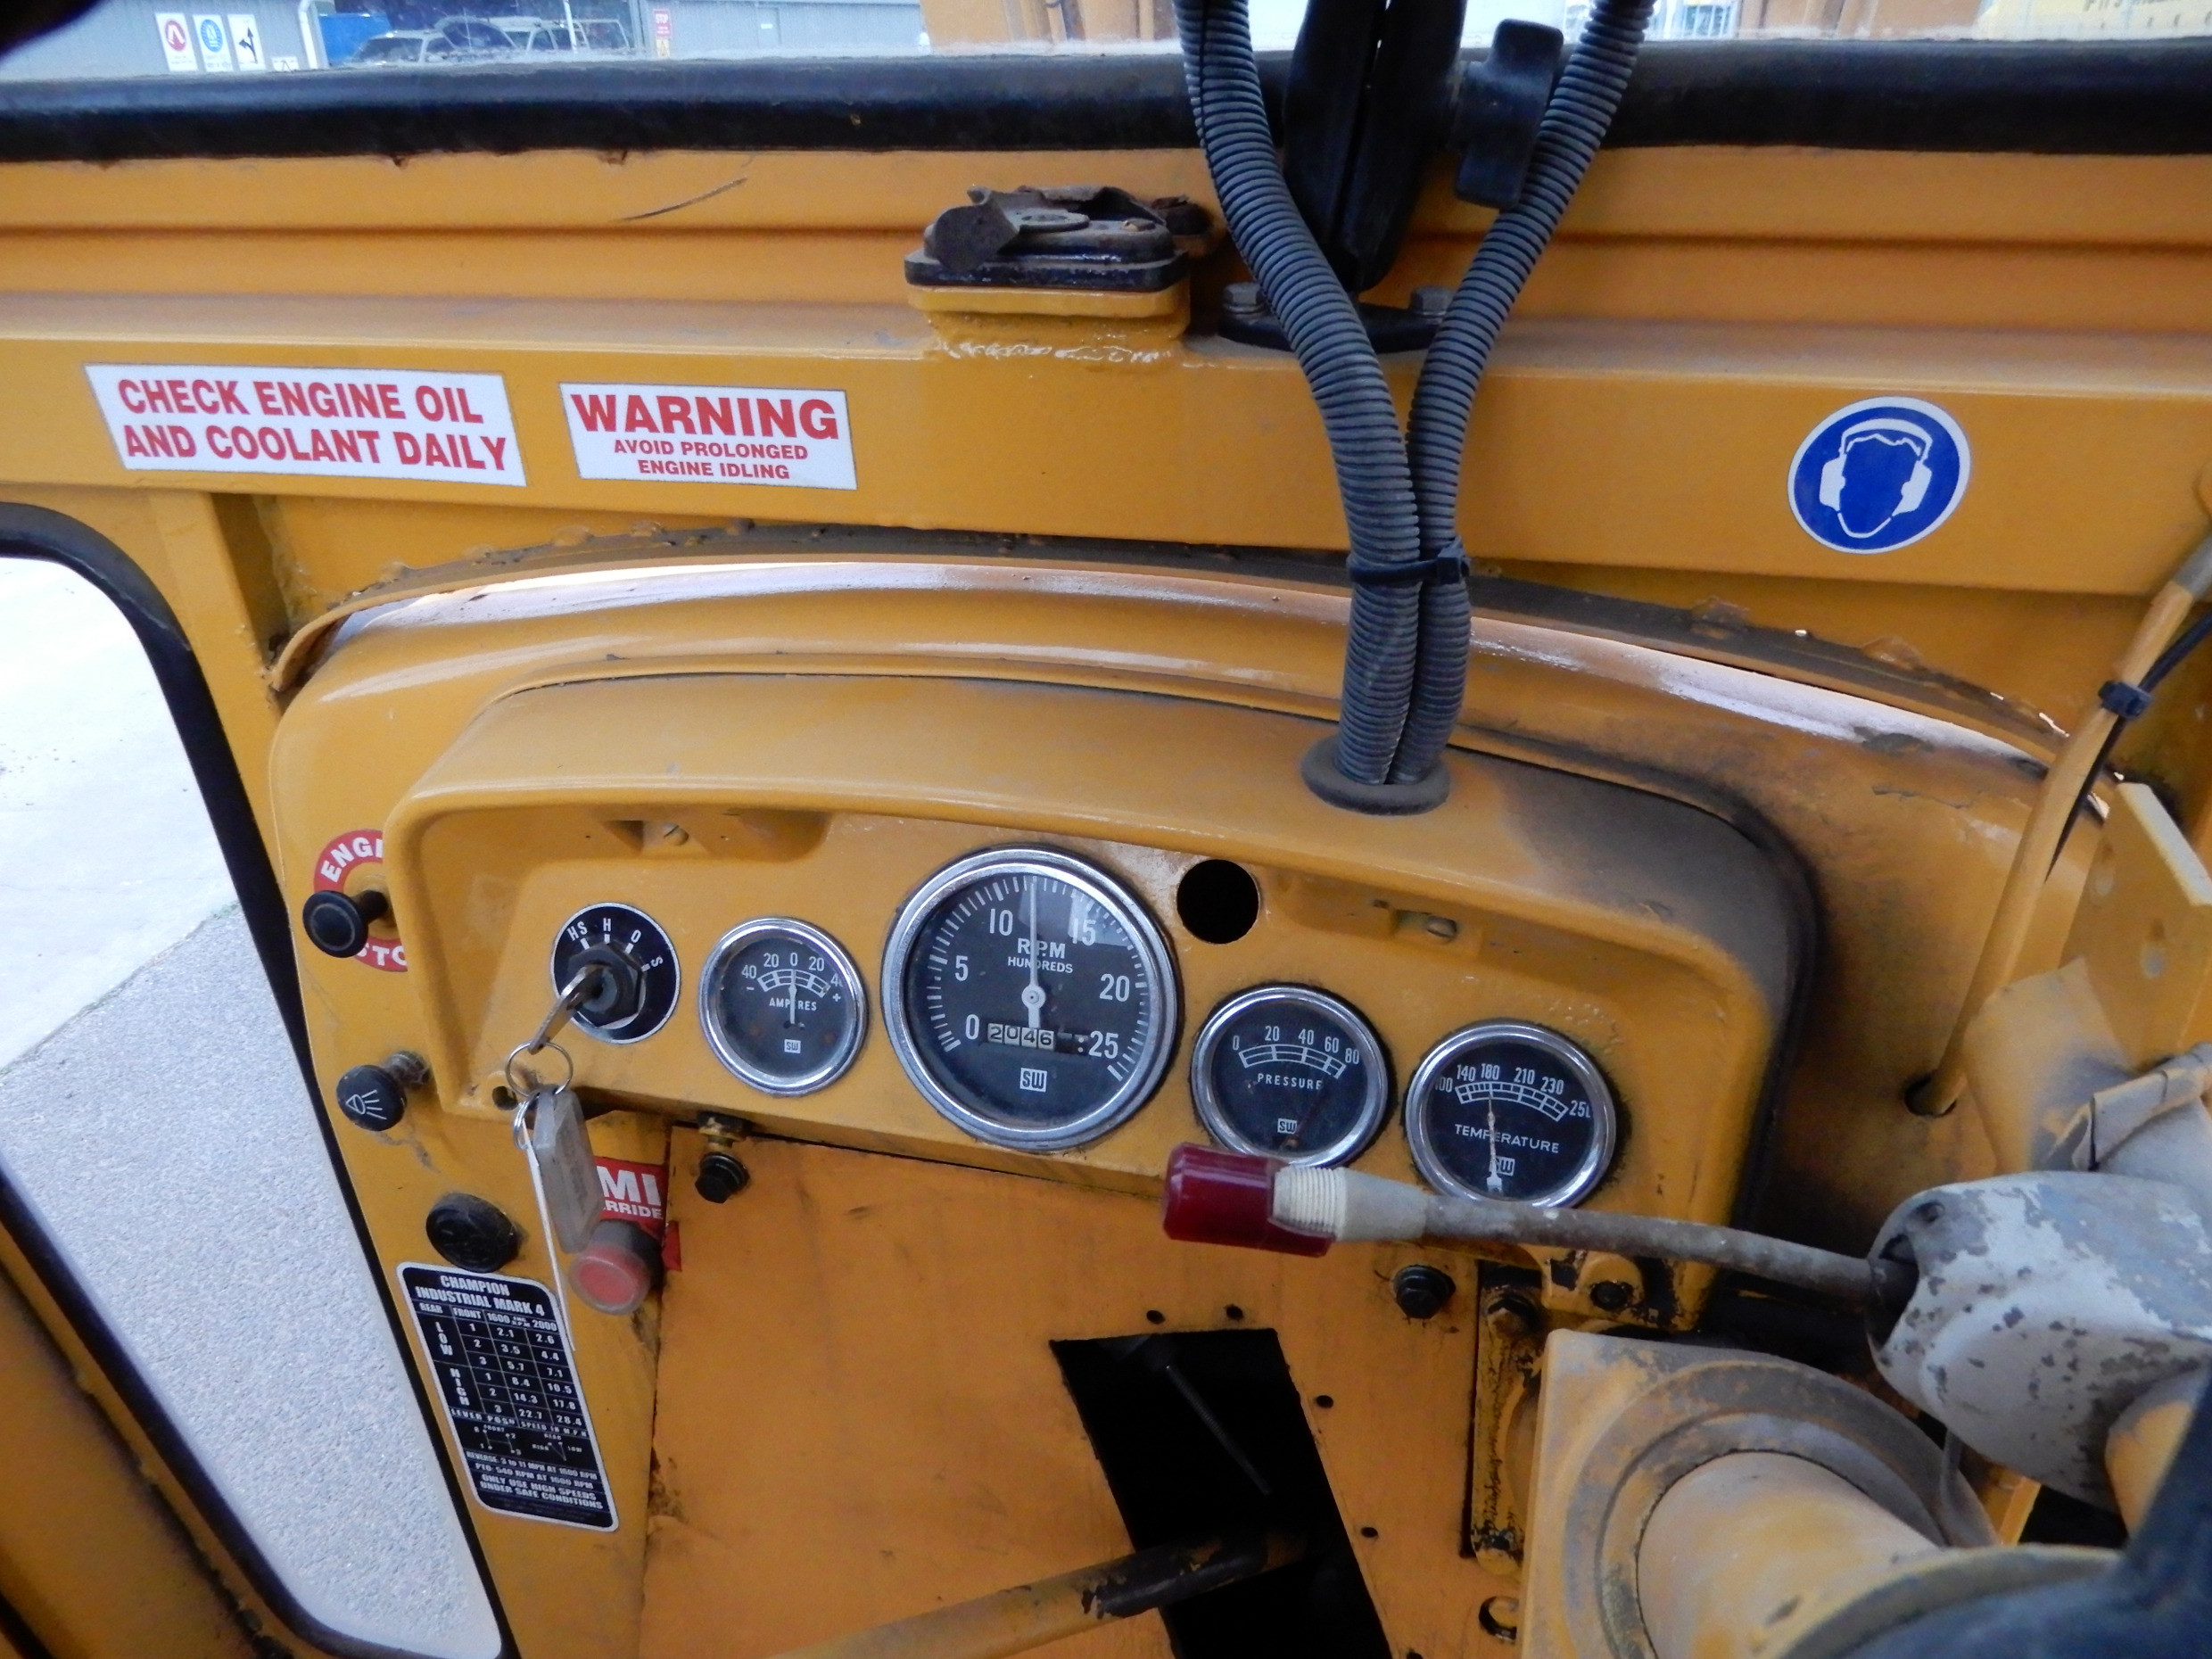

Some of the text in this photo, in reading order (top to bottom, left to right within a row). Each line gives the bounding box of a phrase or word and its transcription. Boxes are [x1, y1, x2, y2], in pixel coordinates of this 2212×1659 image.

[118, 379, 484, 424] CHECK ENGINE OIL
[570, 394, 838, 440] WARNING
[123, 425, 507, 471] AND COOLANT DAILY
[615, 439, 808, 460] AVOID PROLONGED
[637, 459, 790, 479] ENGINE IDLING
[320, 837, 384, 883] ENGI
[988, 908, 1013, 936] 10
[1072, 918, 1097, 946] 15
[356, 942, 409, 966] STO
[567, 920, 588, 941] HS
[603, 918, 611, 931] H
[650, 956, 664, 968] S
[741, 964, 757, 979] 40
[763, 953, 780, 968] 20
[790, 952, 798, 967] 0
[808, 956, 825, 972] 20
[954, 955, 969, 981] 5
[1099, 973, 1130, 1003] 20
[769, 997, 817, 1011] AMPRES
[964, 1013, 979, 1040] 0
[785, 1040, 800, 1052] SW
[1088, 1030, 1119, 1060] 25
[1233, 1026, 1359, 1065] 0 20 40 60 80
[1020, 1069, 1046, 1092] SW
[1258, 1073, 1324, 1091] PRESSURE
[1457, 1064, 1476, 1082] 140
[1481, 1063, 1500, 1080] 180
[1514, 1067, 1536, 1085] 210
[1540, 1076, 1564, 1095] 230
[1454, 1124, 1560, 1154] TEMPERATURE
[440, 1275, 510, 1297] CHAMPION
[415, 1286, 545, 1316] INDUSTRIAL MARK 4
[419, 1302, 443, 1315] REAR
[452, 1307, 482, 1319] FRONT
[487, 1312, 510, 1324] 1600
[469, 1323, 555, 1345] 1 2.1 2.6
[532, 1319, 557, 1332] 2000
[473, 1339, 560, 1361] 2 3.5 4.4
[478, 1356, 564, 1378] 3 5.7 7.1
[485, 1372, 492, 1381] 1
[489, 1388, 498, 1397] 2
[514, 1392, 539, 1404] 14.3
[450, 1409, 483, 1421] LEVER
[494, 1404, 582, 1426] 3 22.7 28.4
[515, 1470, 535, 1480] RPM
[536, 1473, 548, 1482] AT
[574, 1481, 594, 1490] RPM
[547, 1465, 557, 1473] AT
[480, 1481, 513, 1493] UNDER
[515, 1487, 540, 1498] SAFE
[541, 1491, 604, 1509] CONDITIONS
[482, 1473, 597, 1501] ONLY USE HIGH SPEEDS
